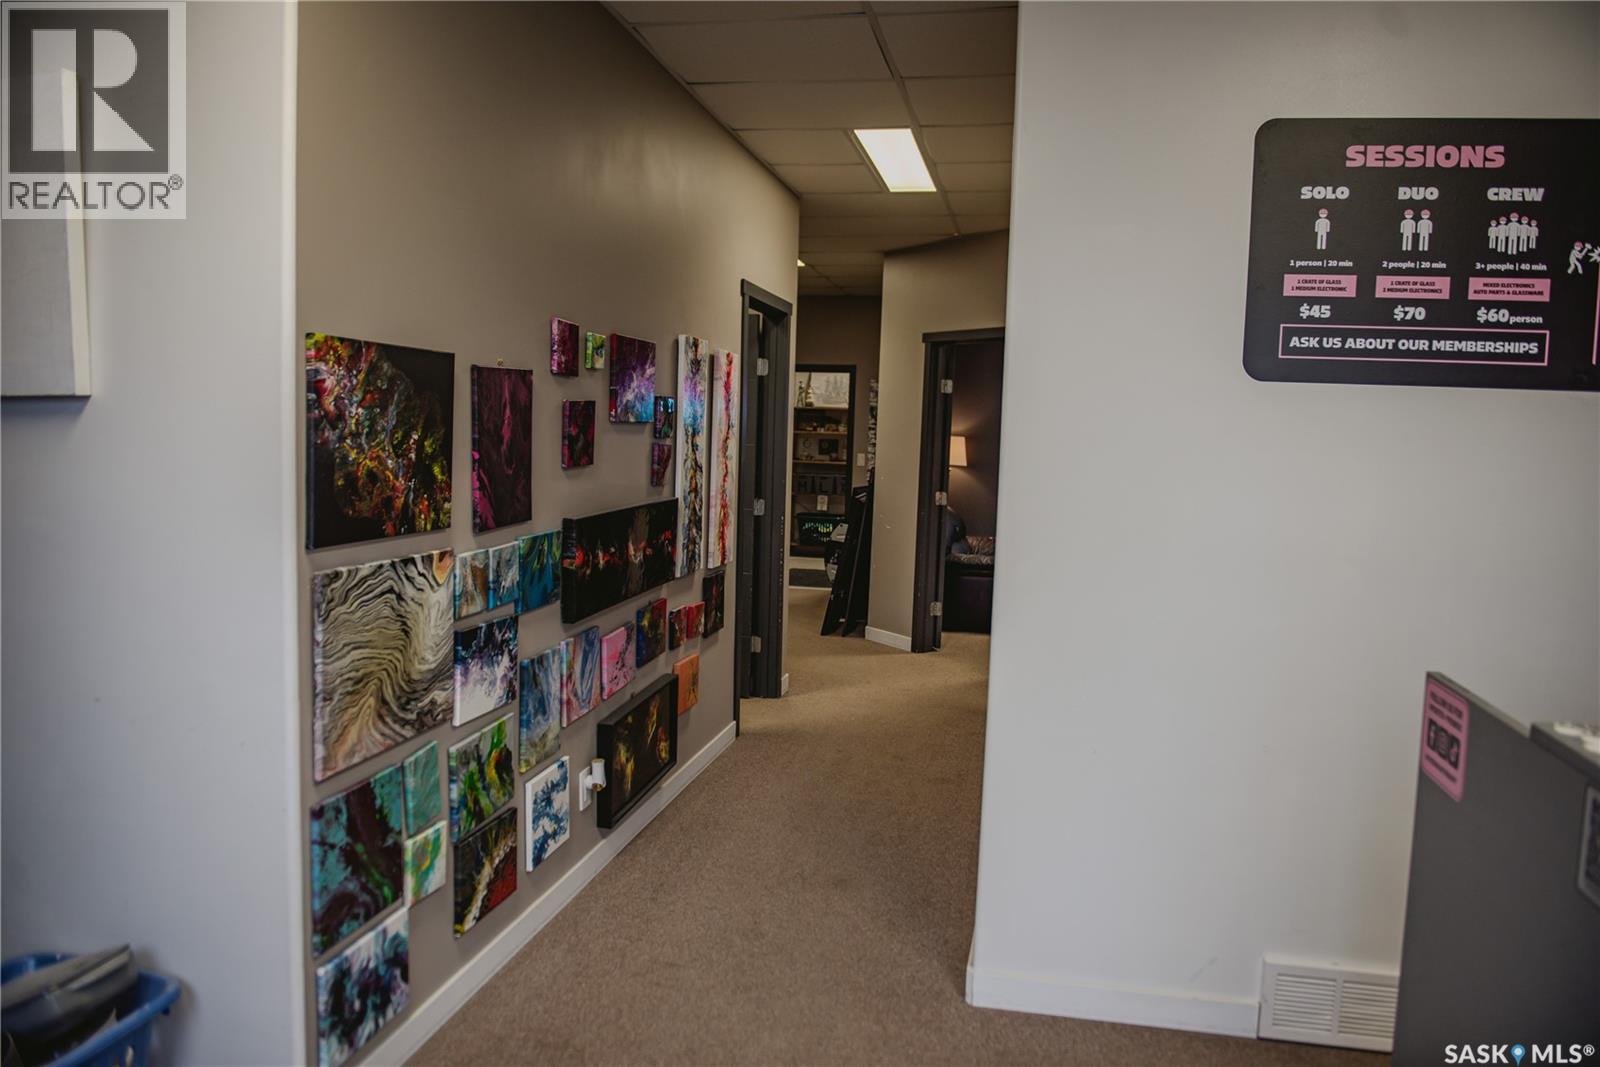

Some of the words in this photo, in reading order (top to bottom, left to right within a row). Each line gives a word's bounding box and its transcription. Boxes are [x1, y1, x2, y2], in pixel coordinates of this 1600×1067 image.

[1345, 144, 1506, 169] SESSIONS
[1300, 185, 1350, 200] SOLO
[1397, 186, 1440, 201] DUO
[1486, 186, 1545, 202] CREW
[1295, 260, 1323, 268] person
[1382, 260, 1388, 268] 2
[1388, 260, 1415, 269] people
[1431, 261, 1447, 269] min
[1475, 262, 1485, 270] 3+
[1486, 262, 1514, 271] people
[1519, 262, 1531, 270] 40
[1531, 262, 1547, 271] min
[1299, 302, 1331, 320] $45
[1393, 304, 1426, 322] $70
[1476, 306, 1510, 324] $60
[1509, 315, 1543, 325] person
[1289, 336, 1320, 348] ASK
[1322, 337, 1342, 349] US
[1344, 337, 1396, 350] ABOUT
[1397, 338, 1430, 351] OUR
[1431, 339, 1539, 354] MEMBERSHIPS
